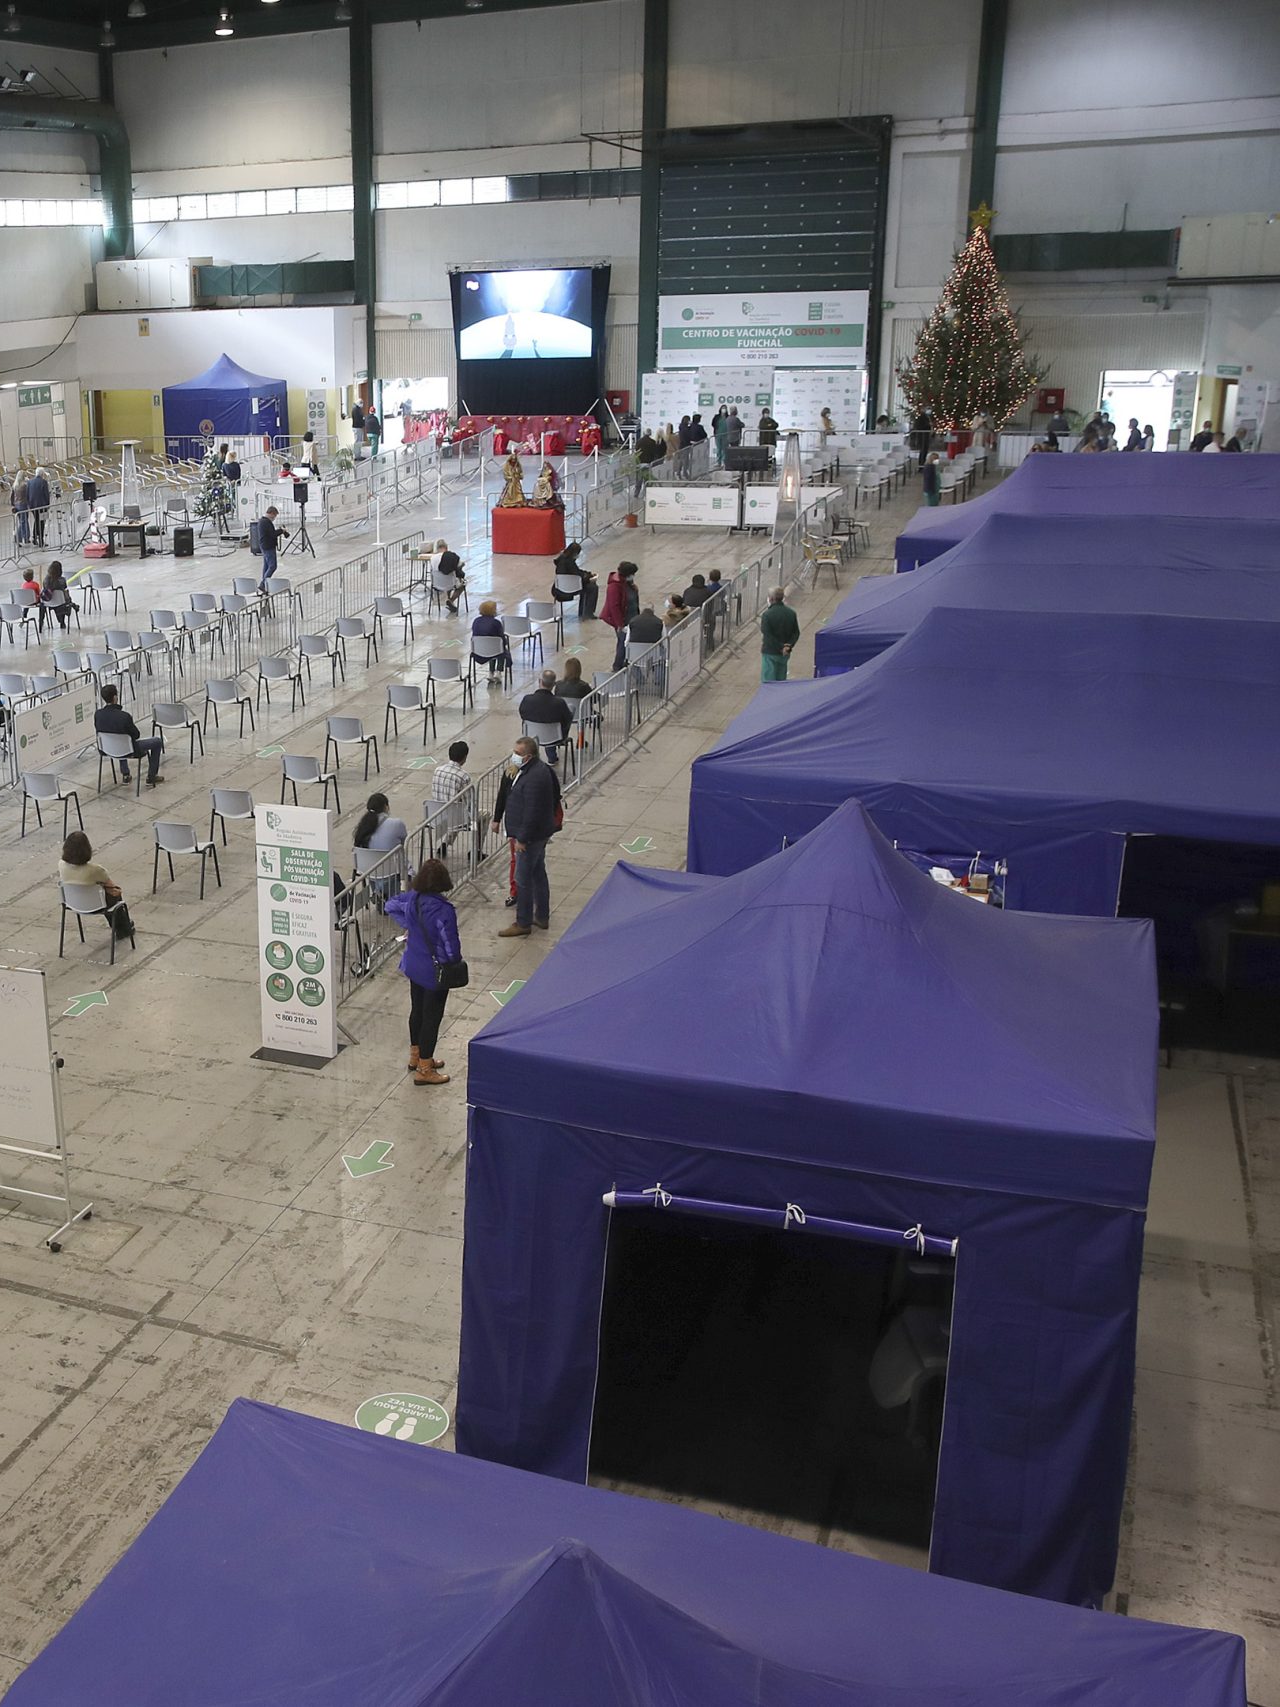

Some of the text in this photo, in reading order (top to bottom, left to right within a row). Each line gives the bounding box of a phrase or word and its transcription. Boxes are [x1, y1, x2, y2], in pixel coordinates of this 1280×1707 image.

[682, 327, 842, 338] CENTRO DE VACINAÇÃO COVID-19
[737, 339, 783, 348] FUNCHAL
[285, 857, 323, 868] OBSERVAÇÃO
[284, 865, 325, 877] PÓS VACINAÇÃO
[291, 875, 318, 884] COVID-19
[281, 1014, 293, 1022] 800
[293, 1016, 305, 1024] 210
[388, 1397, 405, 1406] VEZ
[408, 1402, 426, 1411] SUA
[373, 1400, 442, 1422] AGUARDE AQUI
